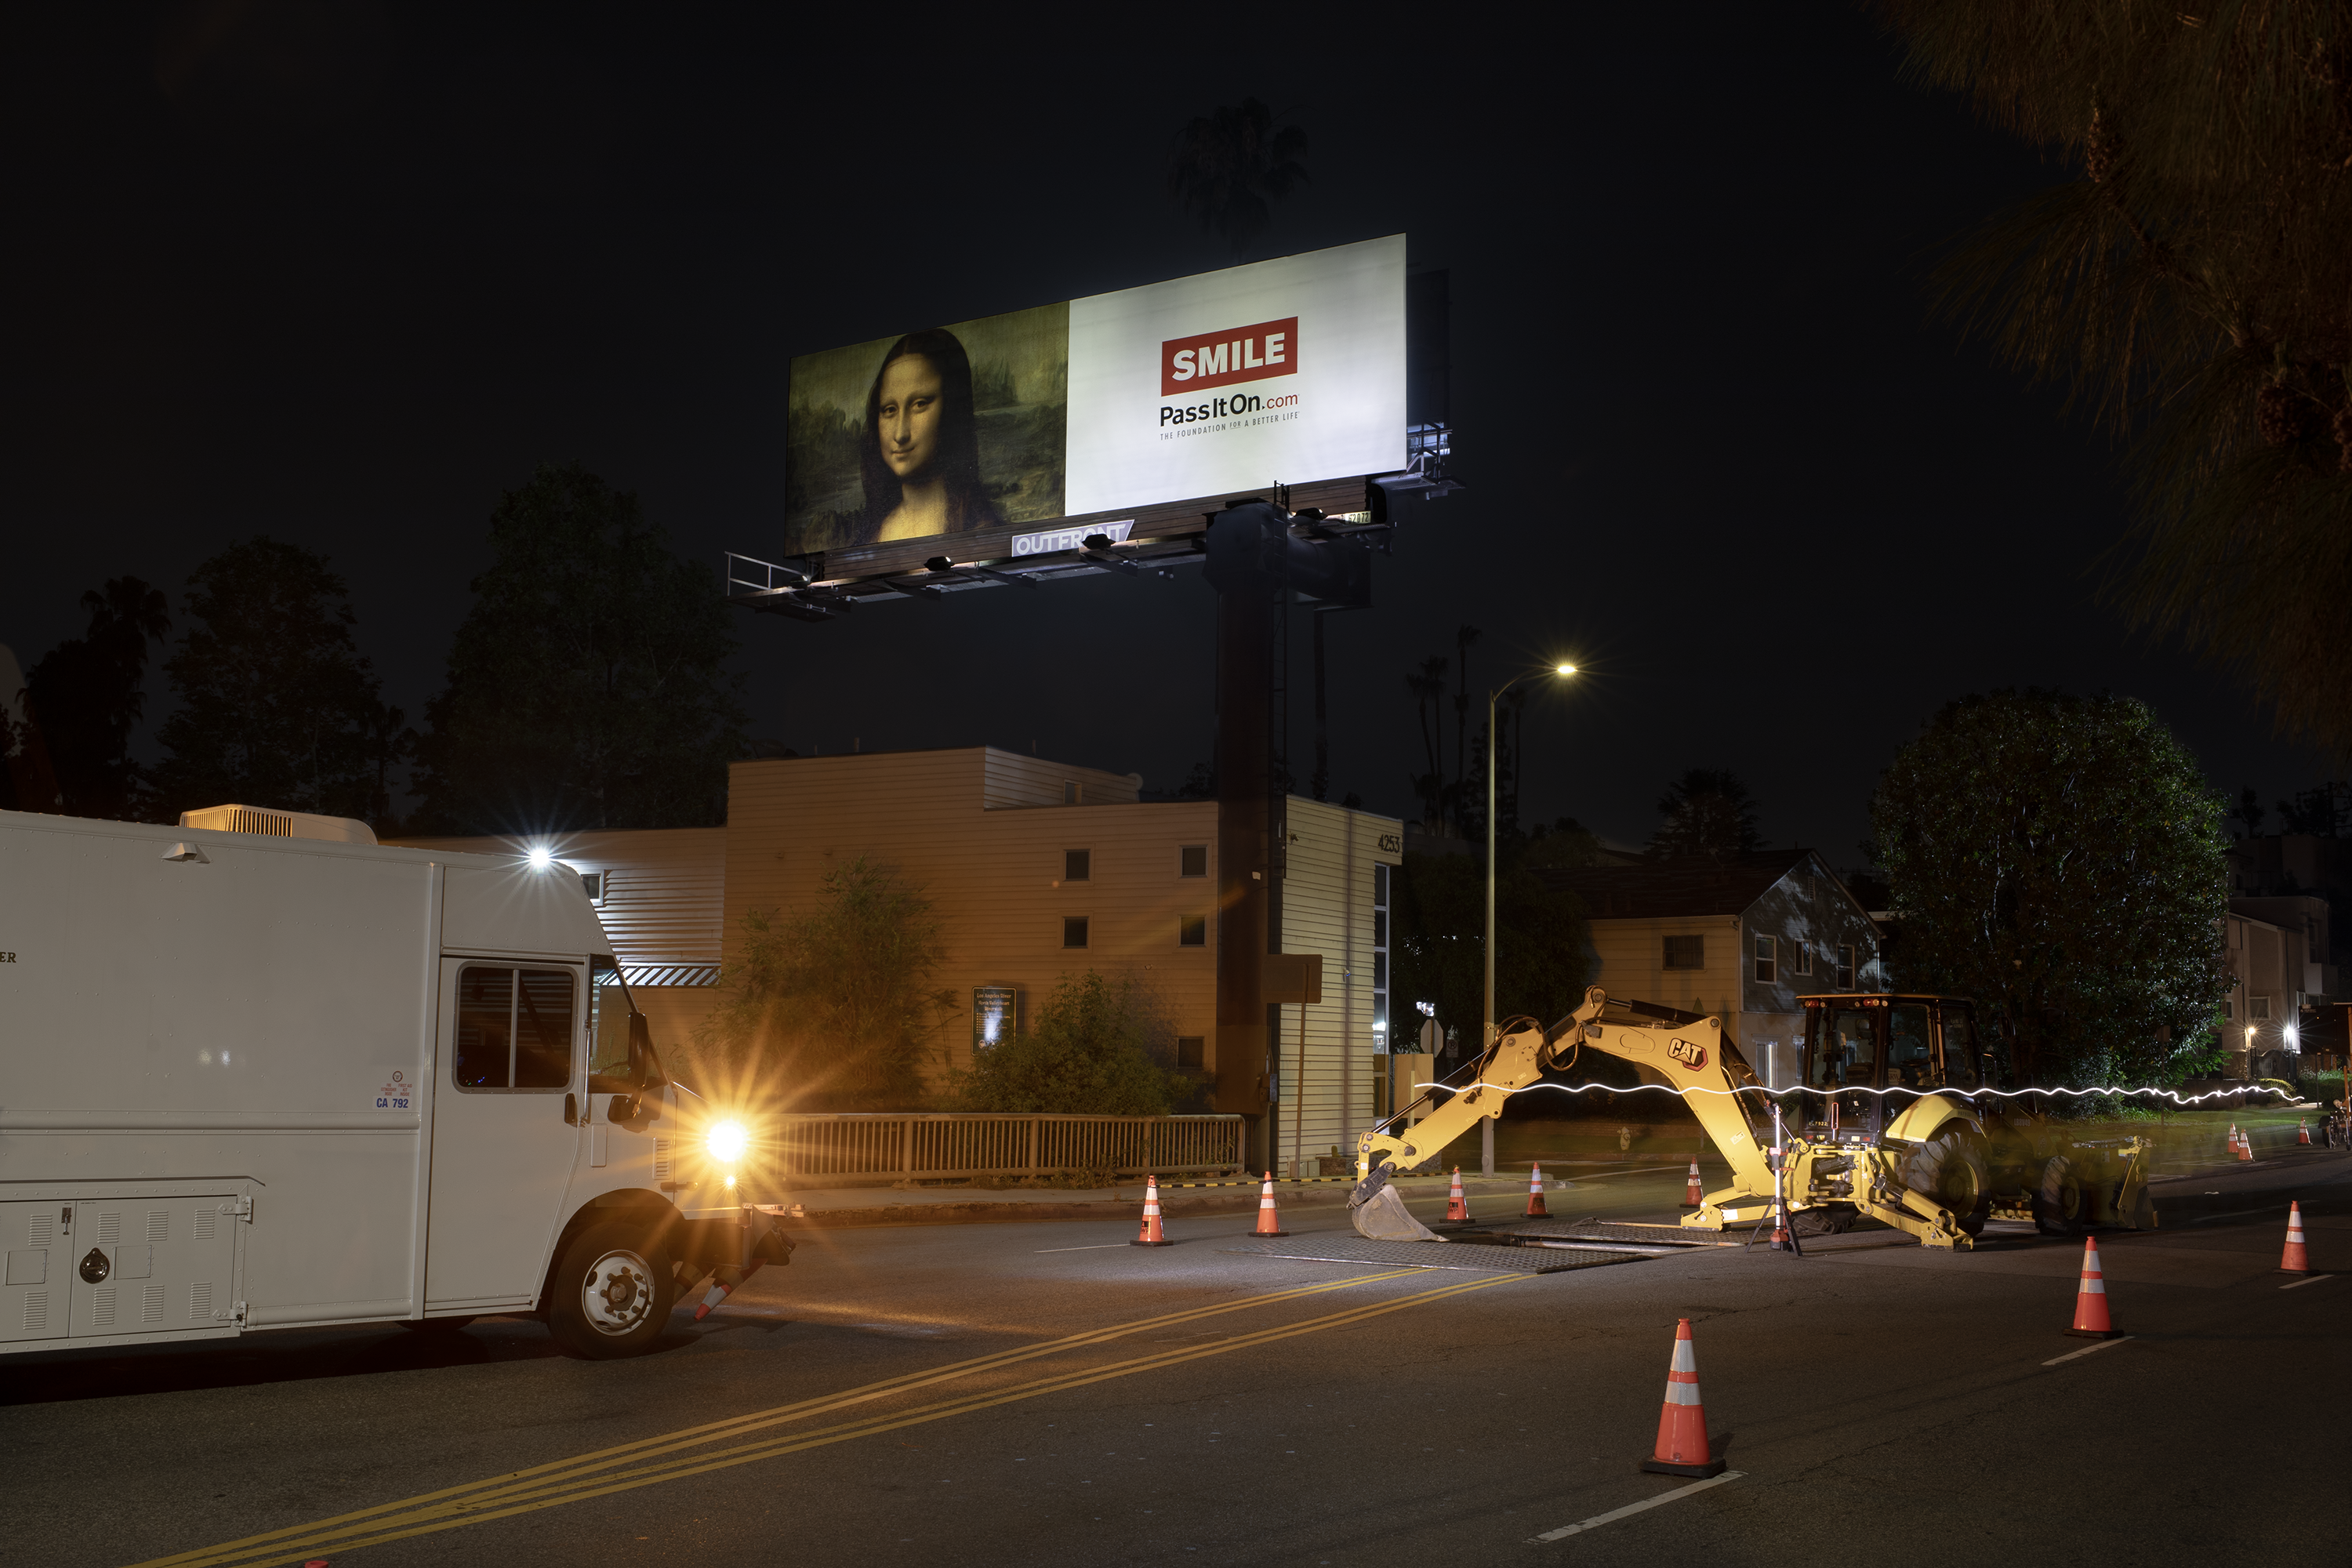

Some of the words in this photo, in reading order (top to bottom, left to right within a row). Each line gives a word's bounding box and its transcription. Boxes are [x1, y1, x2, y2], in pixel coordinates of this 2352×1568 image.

[1171, 332, 1286, 382] SMILE
[1177, 423, 1226, 438] FOUNDATION
[1229, 421, 1241, 430] FOR
[1252, 415, 1279, 426] BETTER
[1283, 412, 1298, 421] LIFE
[1377, 833, 1400, 854] 4253
[1668, 1038, 1702, 1065] CAT
[376, 1098, 388, 1108] CA
[393, 1098, 408, 1109] 792
